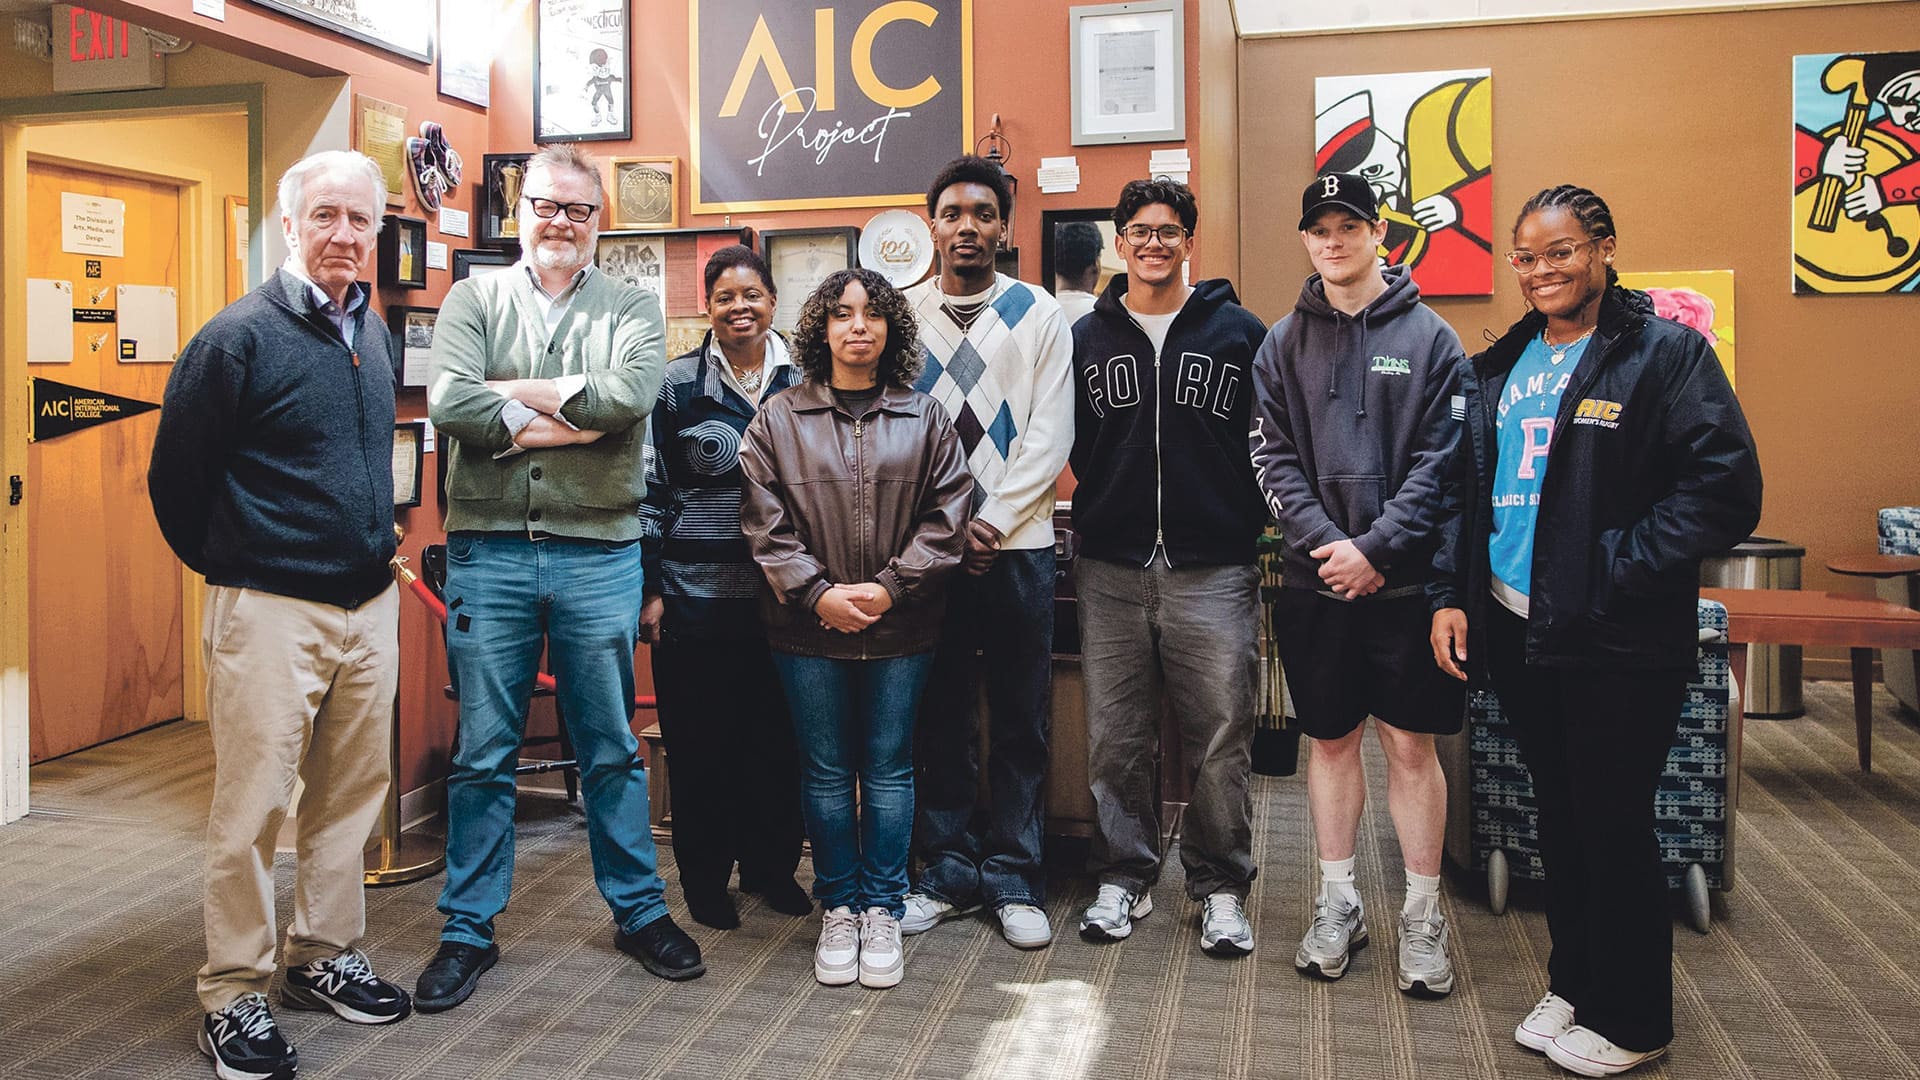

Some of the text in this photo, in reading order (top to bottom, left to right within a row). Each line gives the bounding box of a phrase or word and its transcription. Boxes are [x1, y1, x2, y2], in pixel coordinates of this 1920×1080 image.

[70, 7, 128, 62] EXIT
[718, 0, 942, 117] AIC
[748, 87, 911, 176] Project
[1321, 175, 1339, 198] B
[87, 216, 107, 224] Division
[85, 234, 104, 242] Design
[880, 240, 910, 255] 100
[41, 401, 69, 417] AIC
[1575, 399, 1622, 421] AIC
[1573, 418, 1620, 430] WOMEN'S RUGBY
[1518, 417, 1555, 480] P
